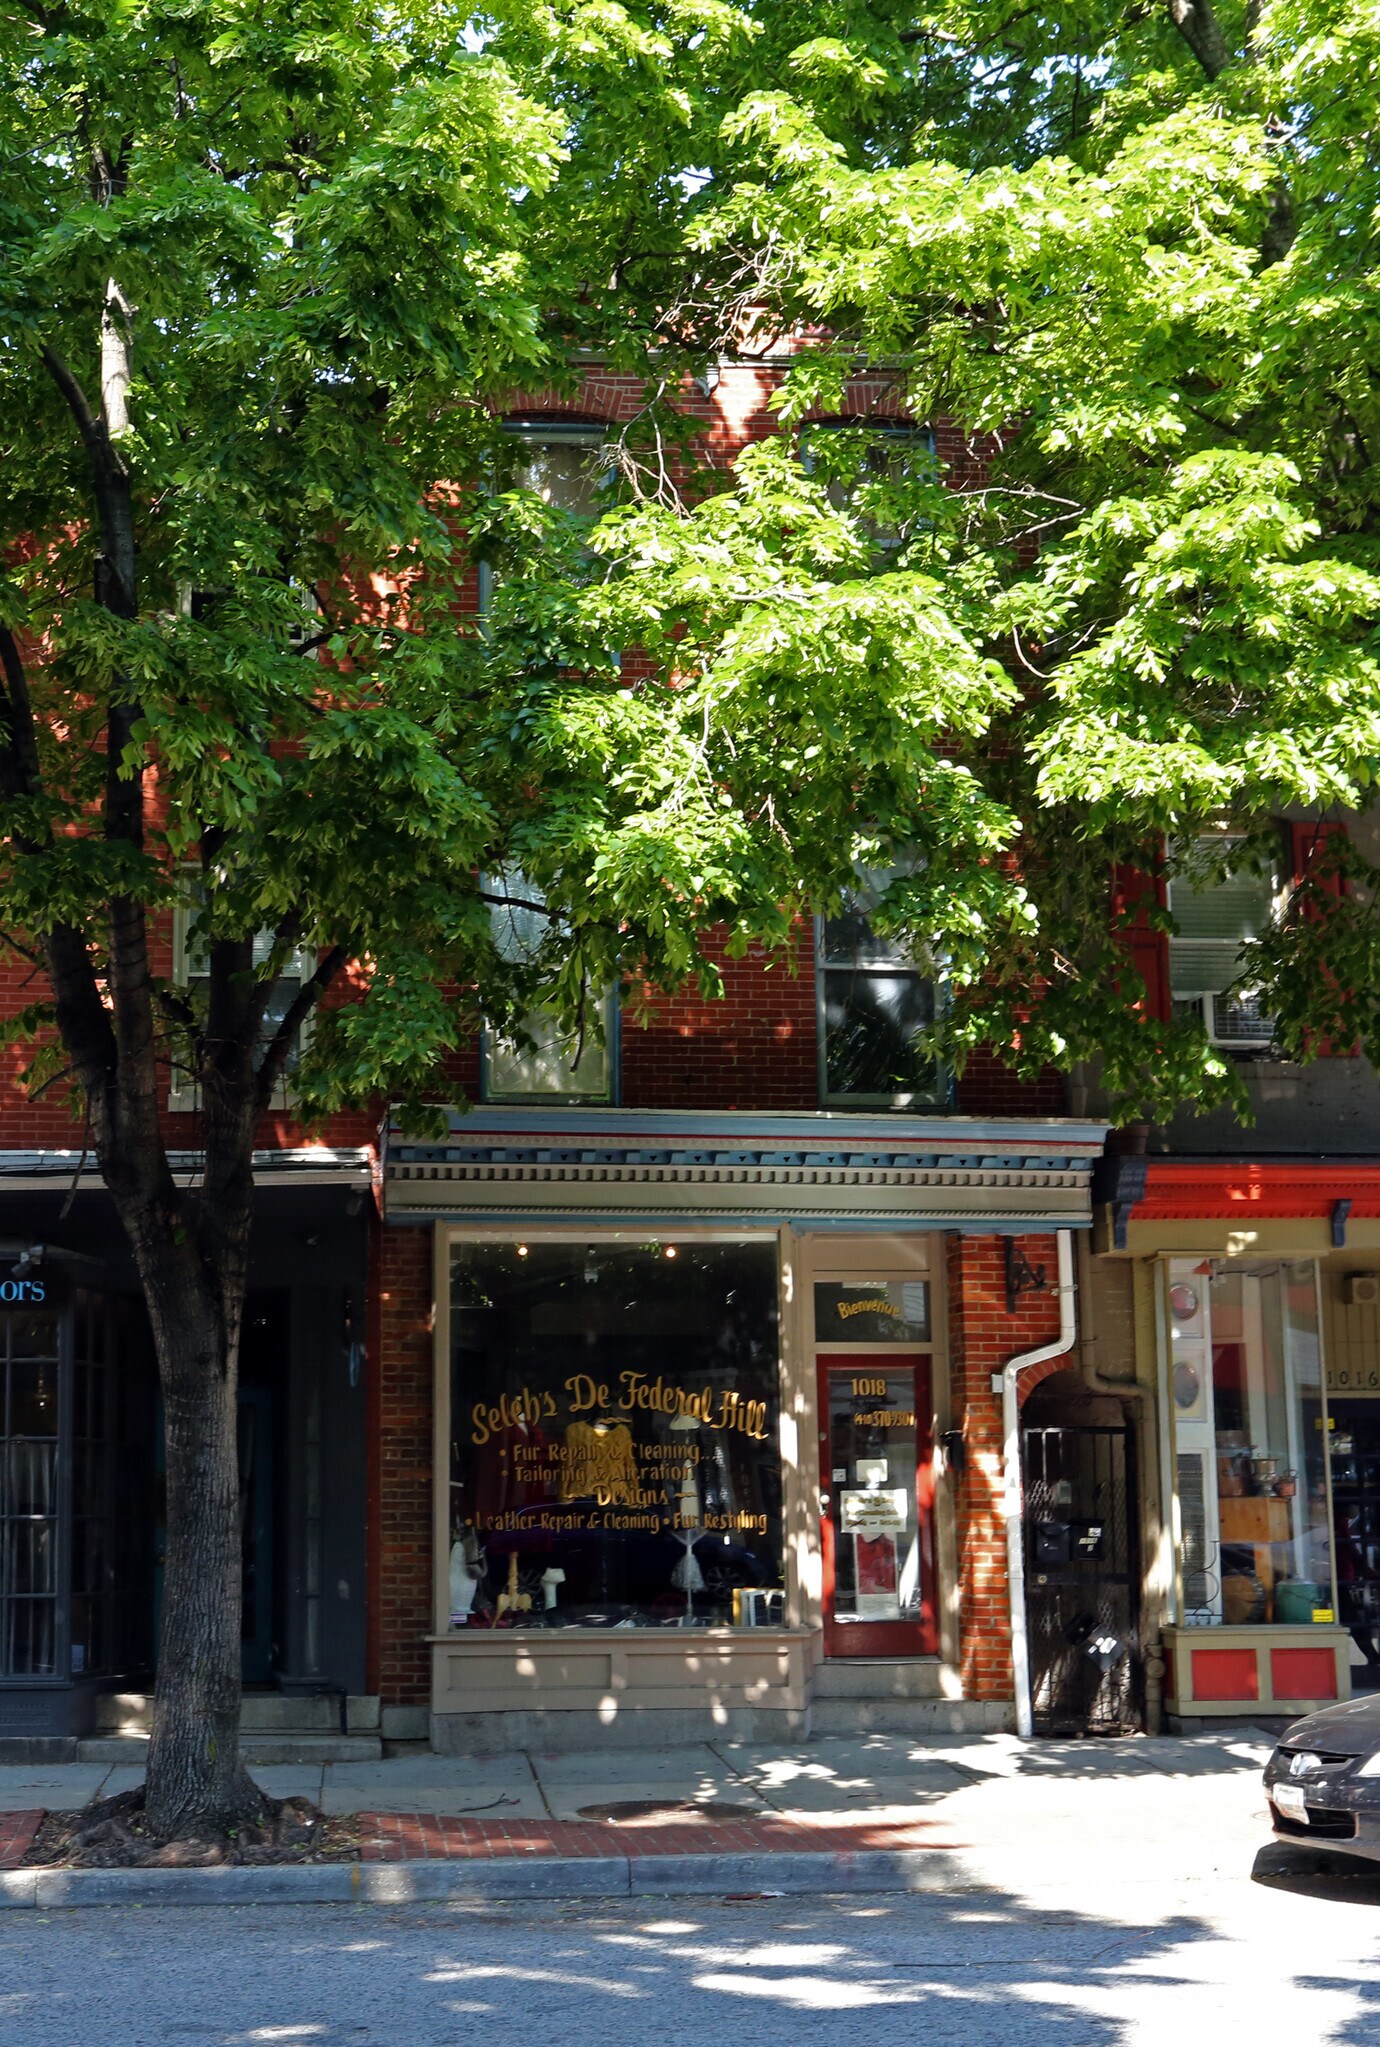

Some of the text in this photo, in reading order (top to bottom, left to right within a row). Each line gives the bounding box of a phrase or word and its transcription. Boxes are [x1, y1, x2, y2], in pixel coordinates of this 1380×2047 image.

[851, 1378, 887, 1396] 1018
[1327, 1370, 1378, 1387] 1016
[564, 1373, 611, 1412] De
[618, 1370, 713, 1423] Federal
[710, 1390, 769, 1440] Hill
[513, 1444, 540, 1462] Fur
[548, 1443, 600, 1464] Repair
[515, 1465, 587, 1486] Tailoring
[476, 1509, 768, 1536] Leather Repair & Cleaning Fur Restyling
